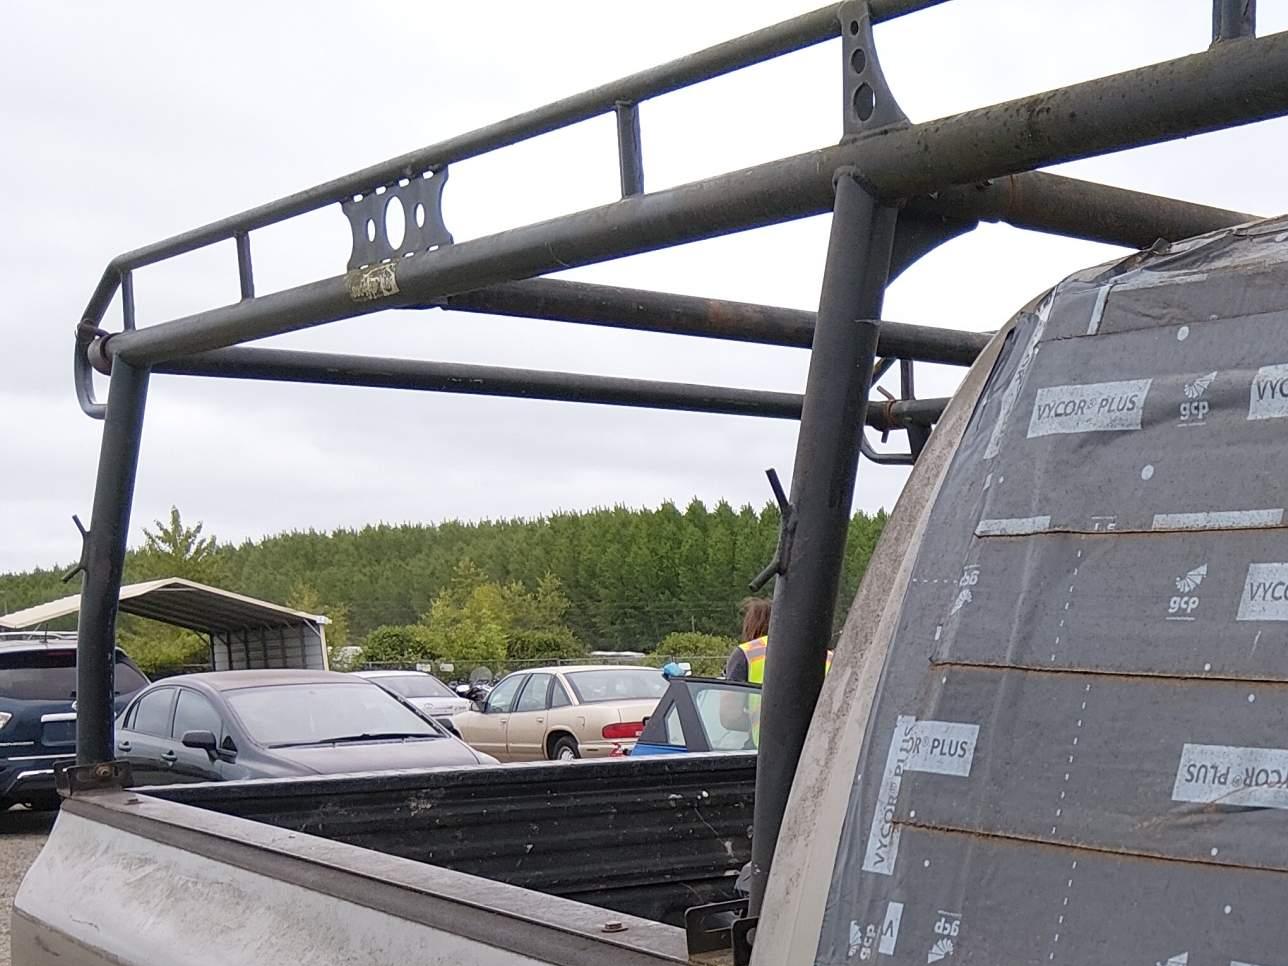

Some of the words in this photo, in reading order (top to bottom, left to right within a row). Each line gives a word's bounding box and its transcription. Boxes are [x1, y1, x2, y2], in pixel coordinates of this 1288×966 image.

[1097, 394, 1139, 415] PLUS
[1179, 400, 1209, 421] gcp
[1168, 595, 1200, 613] gcp
[929, 737, 968, 759] PLUS
[1184, 763, 1231, 786] PLUS
[934, 917, 961, 937] gcp
[859, 923, 877, 961] gcp
